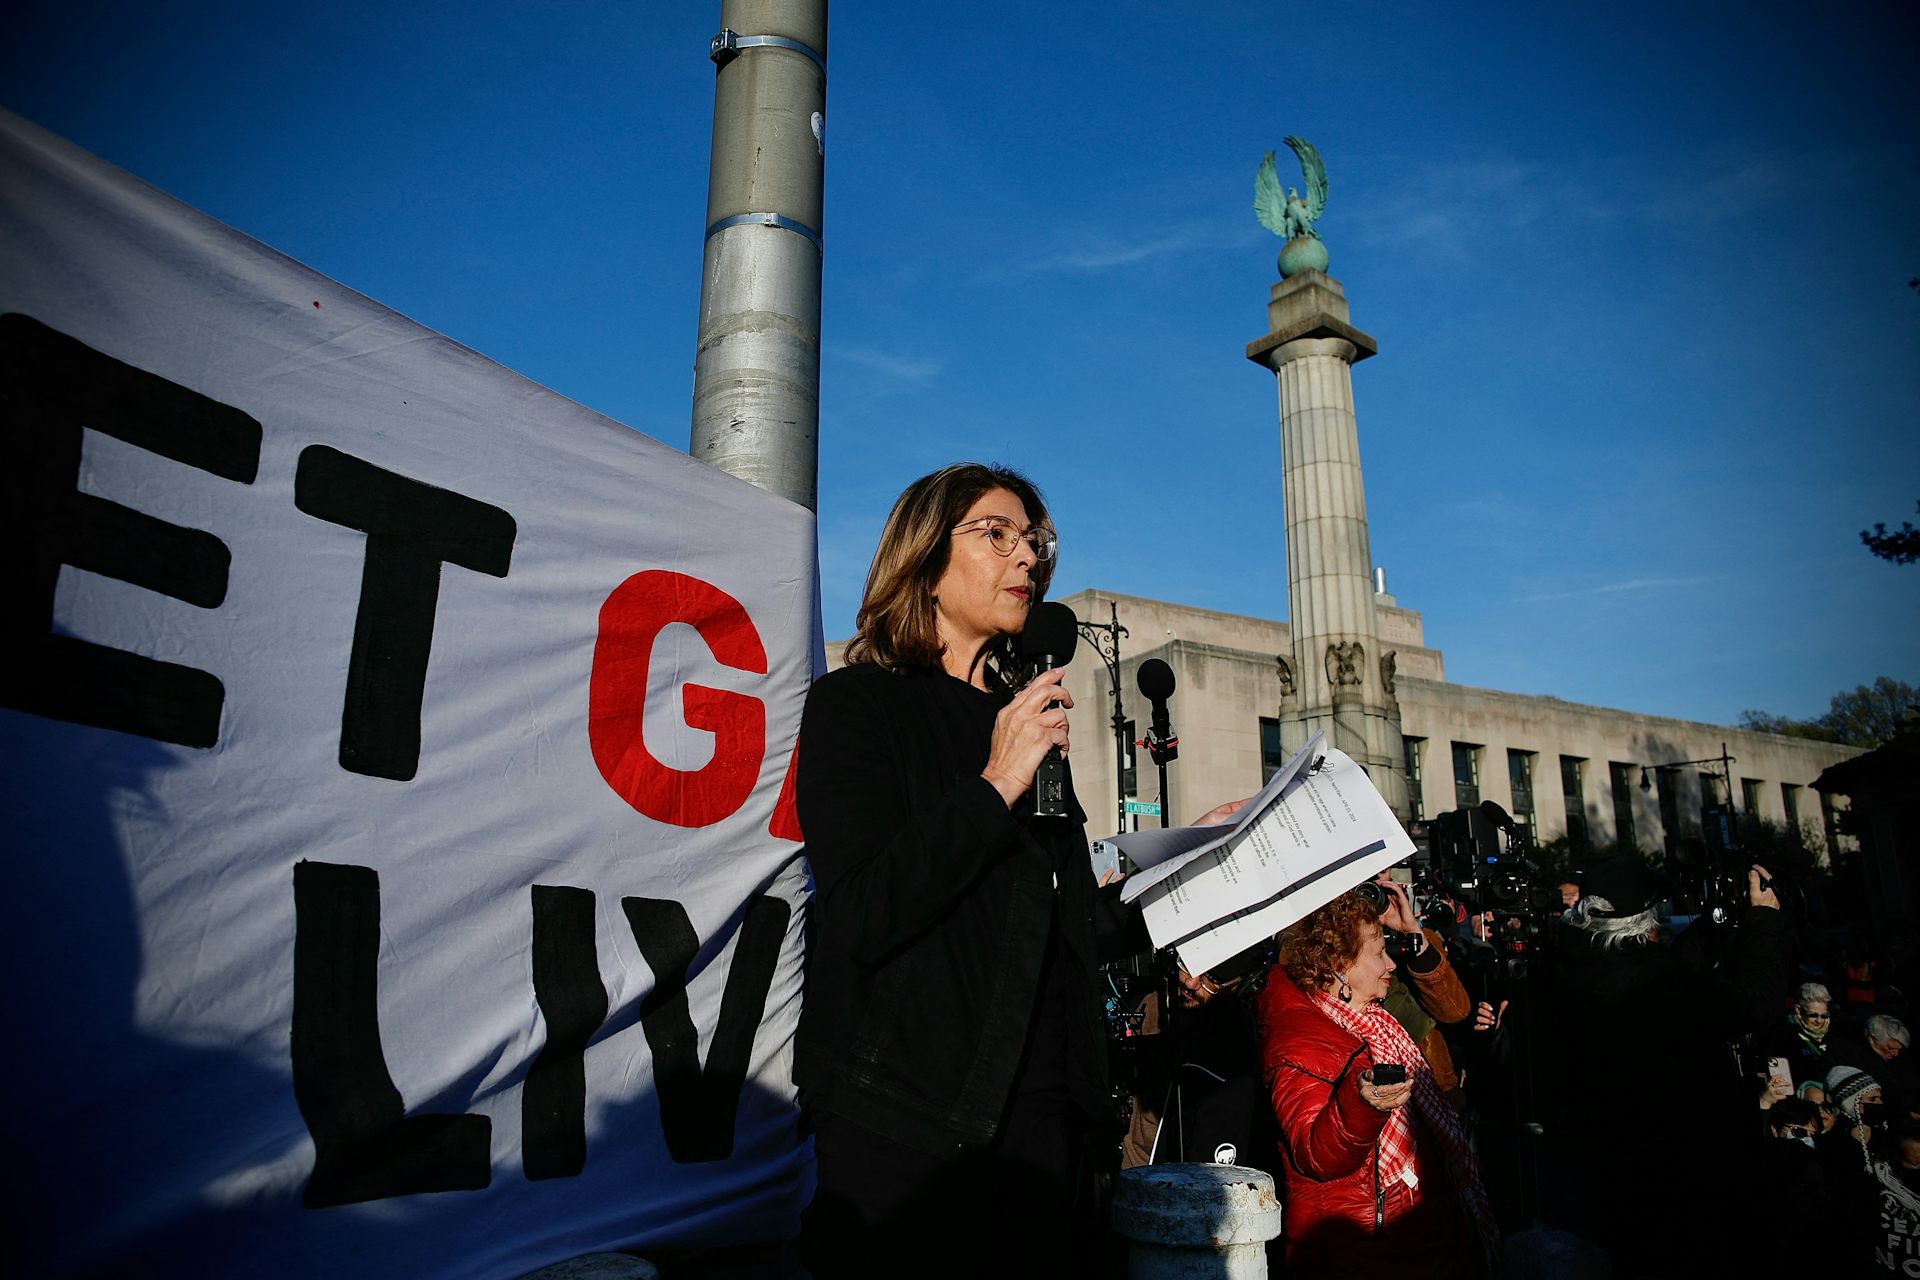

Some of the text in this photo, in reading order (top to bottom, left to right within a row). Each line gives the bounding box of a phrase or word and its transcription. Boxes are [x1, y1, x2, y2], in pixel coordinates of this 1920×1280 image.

[588, 569, 804, 842] G
[1126, 802, 1155, 814] FLATBUSH
[290, 858, 791, 1208] LIV
[1887, 1233, 1920, 1257] FI
